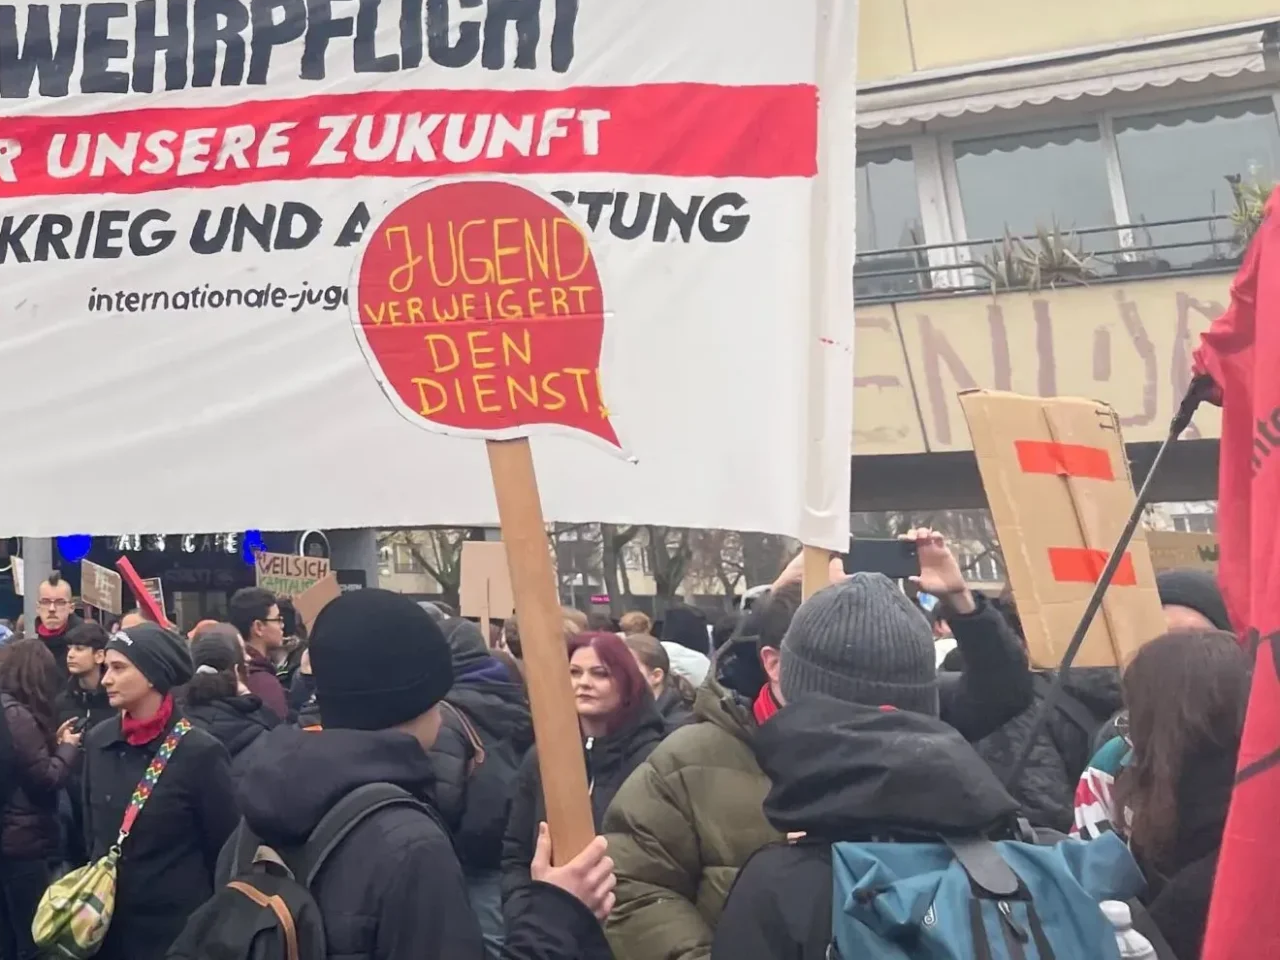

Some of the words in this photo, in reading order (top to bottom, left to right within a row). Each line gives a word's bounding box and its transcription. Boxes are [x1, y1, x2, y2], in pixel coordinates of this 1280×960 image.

[47, 121, 298, 178] UNSERE
[309, 107, 611, 165] ZUKUNFT
[189, 201, 323, 255] UND
[385, 218, 590, 292] JUGEND
[364, 286, 595, 326] VERWEIGERT
[425, 329, 531, 373] DEN
